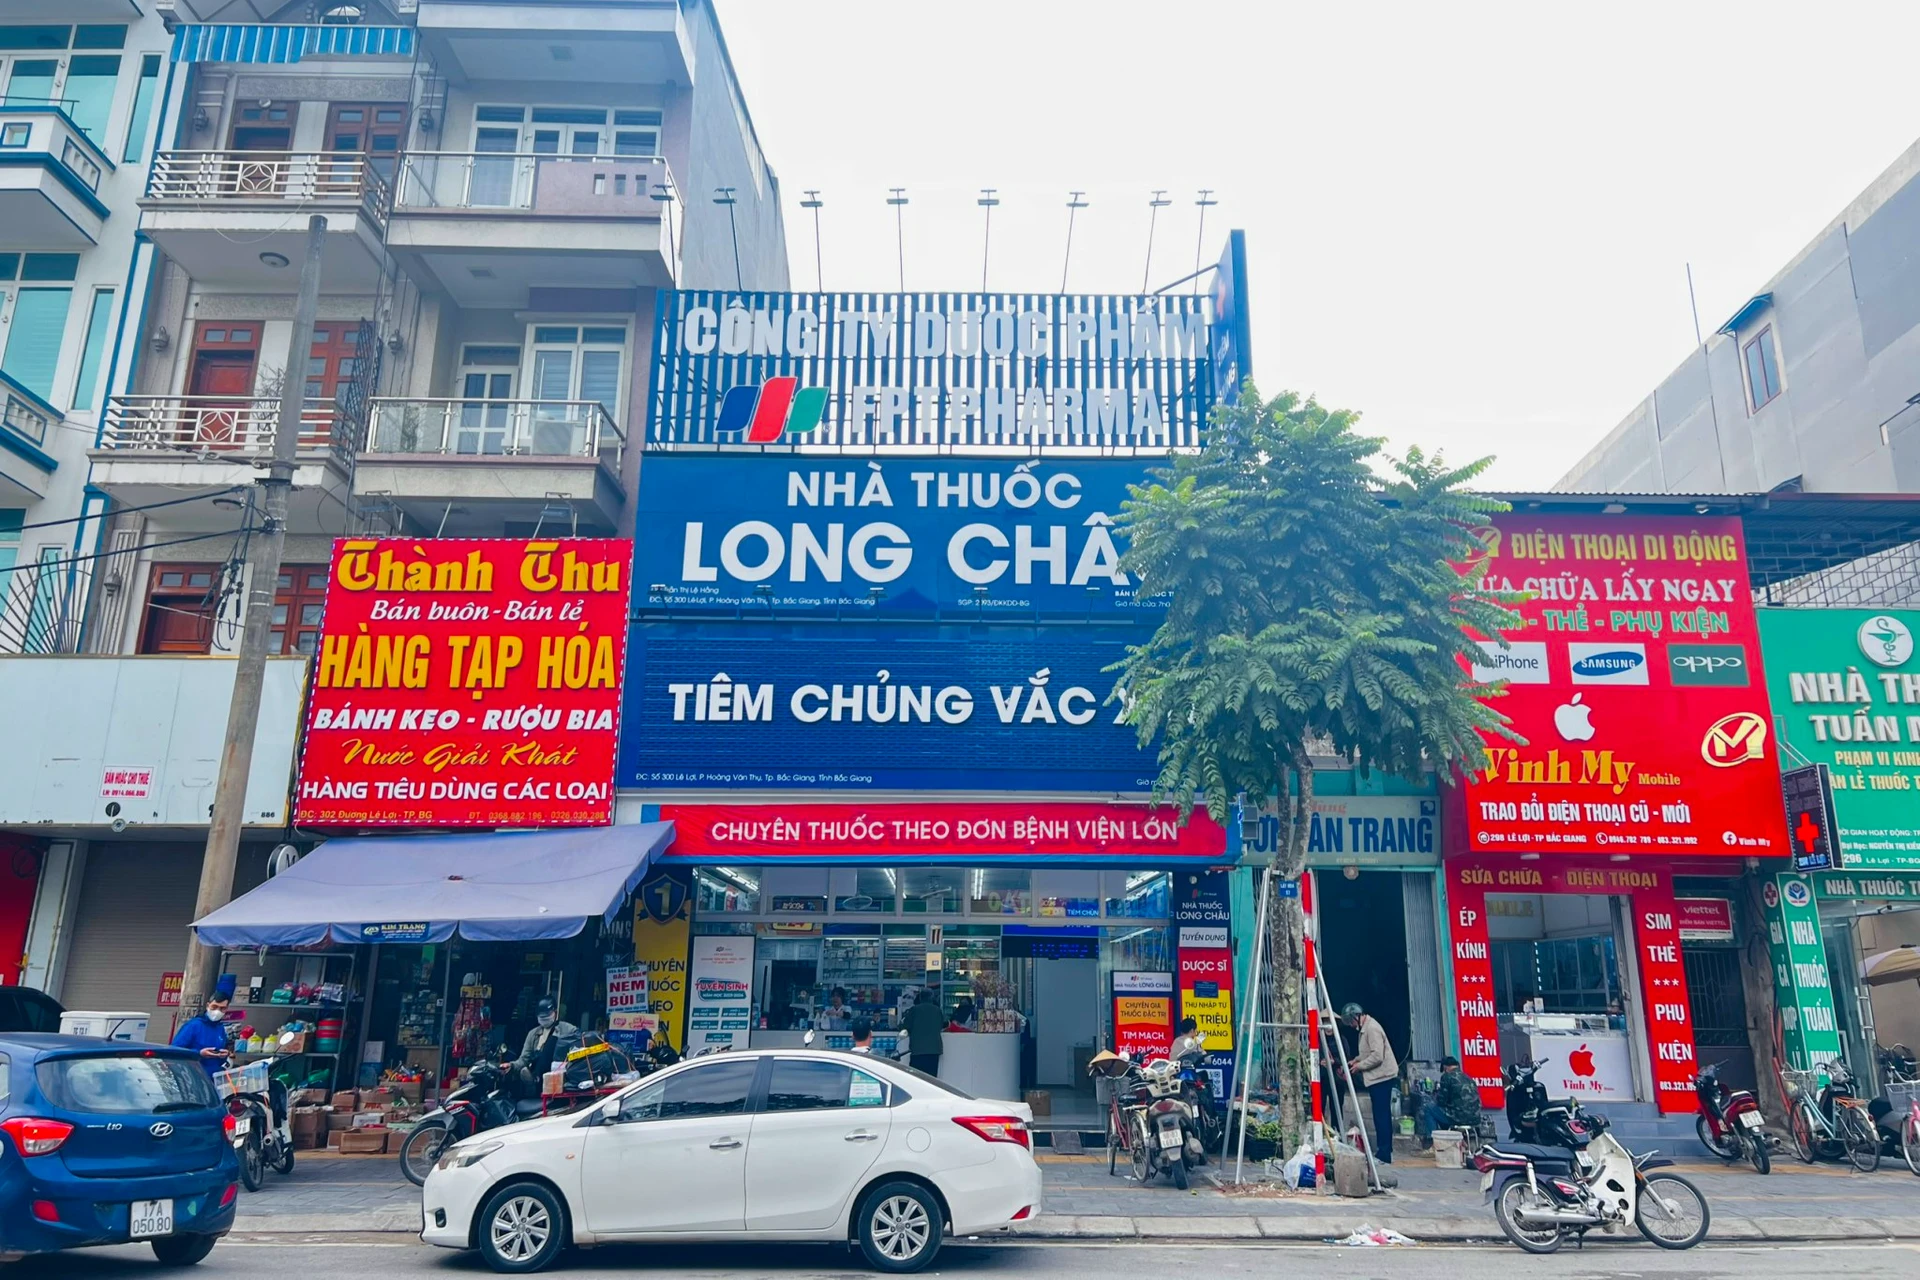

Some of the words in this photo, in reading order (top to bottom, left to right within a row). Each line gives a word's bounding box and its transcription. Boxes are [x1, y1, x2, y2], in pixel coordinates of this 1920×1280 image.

[685, 294, 819, 357] CÔNG
[840, 311, 897, 357] TY
[915, 304, 1049, 366] DƯỢC
[1068, 294, 1208, 359] PHẨM
[850, 386, 941, 434] FPT
[949, 387, 1165, 436] PHARMA
[787, 461, 894, 508] NHÀ
[910, 459, 1083, 509] THUỐC
[681, 520, 914, 584] LONG
[1511, 528, 1564, 565] ĐIỆN
[1571, 533, 1636, 565] THOẠI
[1644, 534, 1666, 560] DI
[1672, 530, 1737, 567] ĐỘNG
[338, 541, 494, 592] Thành
[520, 542, 620, 592] Thu
[1523, 571, 1599, 600] CHỮA
[1604, 567, 1655, 602] LẤY
[1660, 579, 1736, 602] NGAY
[370, 599, 420, 621] Bán
[558, 600, 583, 621] lẻ
[1543, 602, 1589, 631] THẺ
[1611, 610, 1663, 638] PHỤ
[1670, 607, 1730, 638] KIỆN
[318, 622, 431, 689] HÀNG
[448, 635, 523, 700] TẠP
[537, 622, 616, 690] HÓA
[1494, 655, 1539, 669] iPhone
[1581, 658, 1636, 669] SAMSUNG
[1673, 656, 1742, 673] oppo
[1789, 666, 1871, 703] NHÀ
[669, 671, 773, 722] TIÊM
[790, 669, 974, 725] CHỦNG
[989, 667, 1098, 725] VẮC
[313, 702, 397, 730] BÁNH
[399, 709, 460, 735] KẸO
[481, 703, 563, 738] RƯỢU
[566, 709, 613, 730] BIA
[1809, 705, 1900, 742] TUẤN
[341, 738, 416, 766] Nước
[422, 740, 489, 773] Giải
[501, 739, 579, 766] Khát
[1835, 751, 1873, 768] PHẠM
[1877, 751, 1890, 766] VI
[706, 773, 731, 784] Hoàng
[765, 774, 775, 784] Tp.
[777, 773, 792, 782] Bắc
[834, 773, 848, 782] Bắc
[850, 774, 872, 784] Giang
[1483, 747, 1572, 785] Vinh
[1577, 750, 1635, 795] My
[1638, 772, 1681, 786] Mobile
[1849, 768, 1866, 789] LẺ
[1869, 770, 1911, 790] THUỐC
[302, 775, 368, 800] HÀNG
[374, 777, 425, 800] TIÊU
[430, 777, 497, 801] DÙNG
[502, 775, 550, 801] CÁC
[555, 781, 607, 805] LOẠI
[319, 810, 336, 818] 302
[418, 811, 433, 819] BG
[1480, 801, 1517, 821] TRAO
[1521, 793, 1544, 821] ĐỔI
[1548, 800, 1580, 826] ĐIỆN
[1584, 802, 1626, 826] THOẠI
[1630, 799, 1649, 823] CŨ
[1662, 799, 1691, 824] MỚI
[711, 814, 800, 841] CHUYÊN
[807, 814, 889, 842] THUỐC
[892, 819, 951, 841] THEO
[956, 816, 1006, 842] ĐƠN
[1013, 815, 1072, 847] BỆNH
[1076, 815, 1126, 846] VIỆN
[1132, 815, 1178, 841] LỚN
[1348, 817, 1433, 853] TRANG
[1507, 832, 1518, 843] LÊ
[1563, 833, 1587, 843] GIANG
[1843, 853, 1862, 864] 296
[1461, 864, 1496, 885] SỬA
[1498, 866, 1543, 886] CHỮA
[1566, 867, 1605, 889] ĐIỆN
[1609, 871, 1658, 890] THOẠI
[1825, 876, 1855, 895] NHÀ
[1859, 874, 1905, 896] THUỐC
[1176, 911, 1202, 920] LONG
[1204, 911, 1230, 920] CHÂU
[1182, 901, 1197, 909] NHÀ
[1198, 900, 1223, 910] THUỐC
[1683, 906, 1720, 914] viettel
[1459, 906, 1477, 927] ÉP
[1645, 912, 1672, 930] SIM
[1205, 934, 1226, 943] DỤNG
[1790, 917, 1817, 945] NHÀ
[1456, 938, 1487, 959] KÍNH
[1647, 941, 1678, 963] THẺ
[1182, 960, 1214, 974] DƯỢC
[1217, 959, 1227, 972] SĨ
[1794, 954, 1827, 988] THUỐC
[609, 980, 645, 993] NEM
[726, 983, 748, 991] SINH
[1120, 1009, 1141, 1017] THUỐC
[1125, 1001, 1150, 1009] CHUYÊN
[1199, 1001, 1217, 1009] NHẬP
[1460, 993, 1494, 1018] PHẦN
[1655, 1004, 1686, 1025] PHỤ
[1802, 998, 1833, 1031] TUẤN
[1199, 1012, 1228, 1027] TRIỆU
[1122, 1031, 1138, 1039] TIM
[1464, 1031, 1497, 1057] MỀM
[1212, 1057, 1232, 1066] 6044
[1658, 1040, 1693, 1064] KIỆN
[1563, 1079, 1585, 1090] Vinh
[1589, 1080, 1603, 1093] My
[142, 1202, 163, 1217] 17A
[132, 1218, 171, 1234] 050.80
